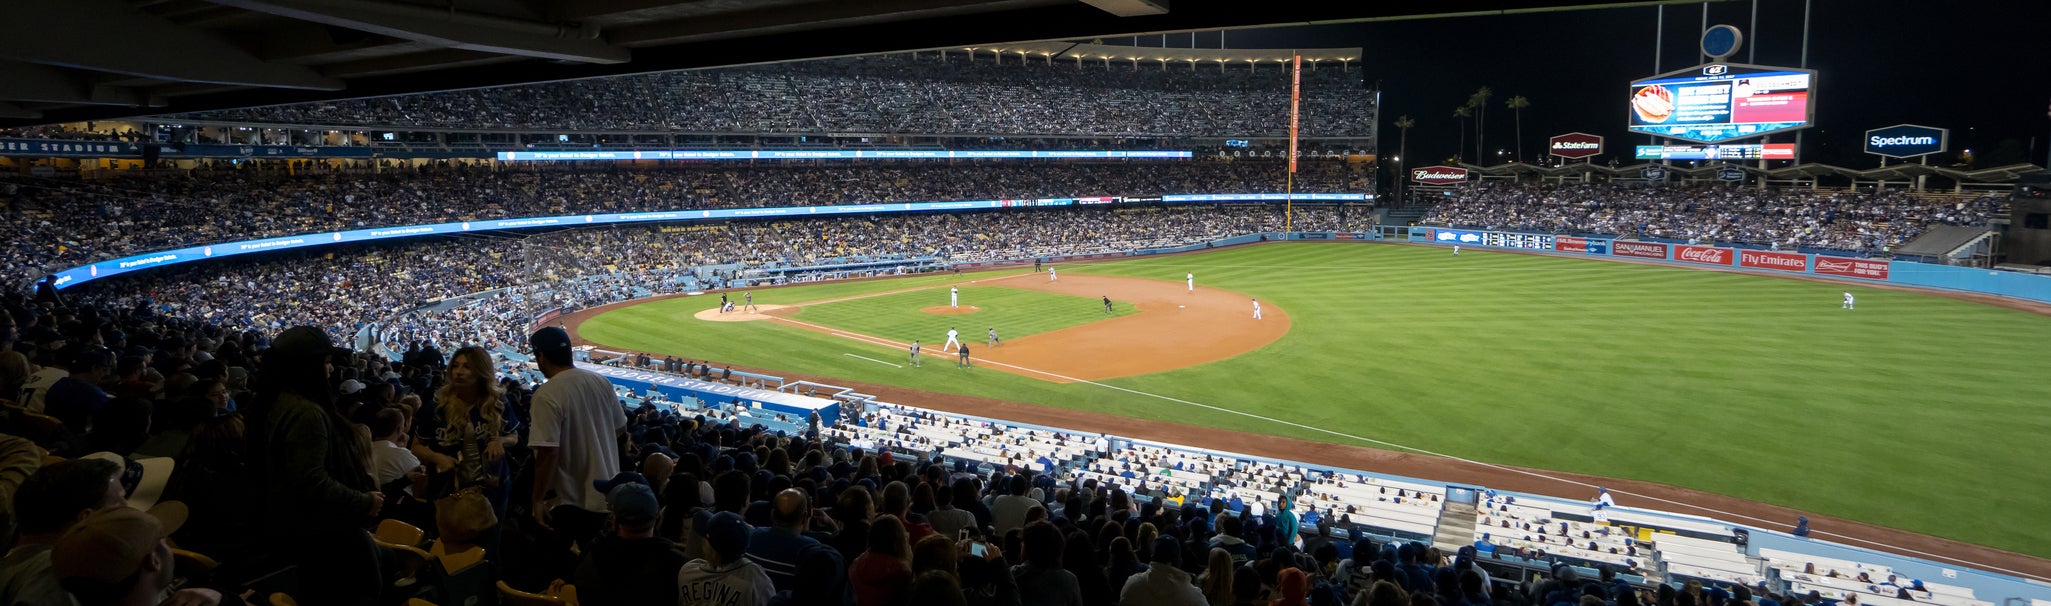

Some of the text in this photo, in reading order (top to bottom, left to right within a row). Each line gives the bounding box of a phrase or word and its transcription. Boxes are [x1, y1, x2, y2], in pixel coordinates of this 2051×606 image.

[41, 144, 118, 152] STADIUM
[1870, 136, 1932, 148] Spectrum
[1414, 169, 1465, 179] Budweiser
[1742, 253, 1805, 267] Fly Emirates
[602, 368, 776, 399] DODGER STADIUM
